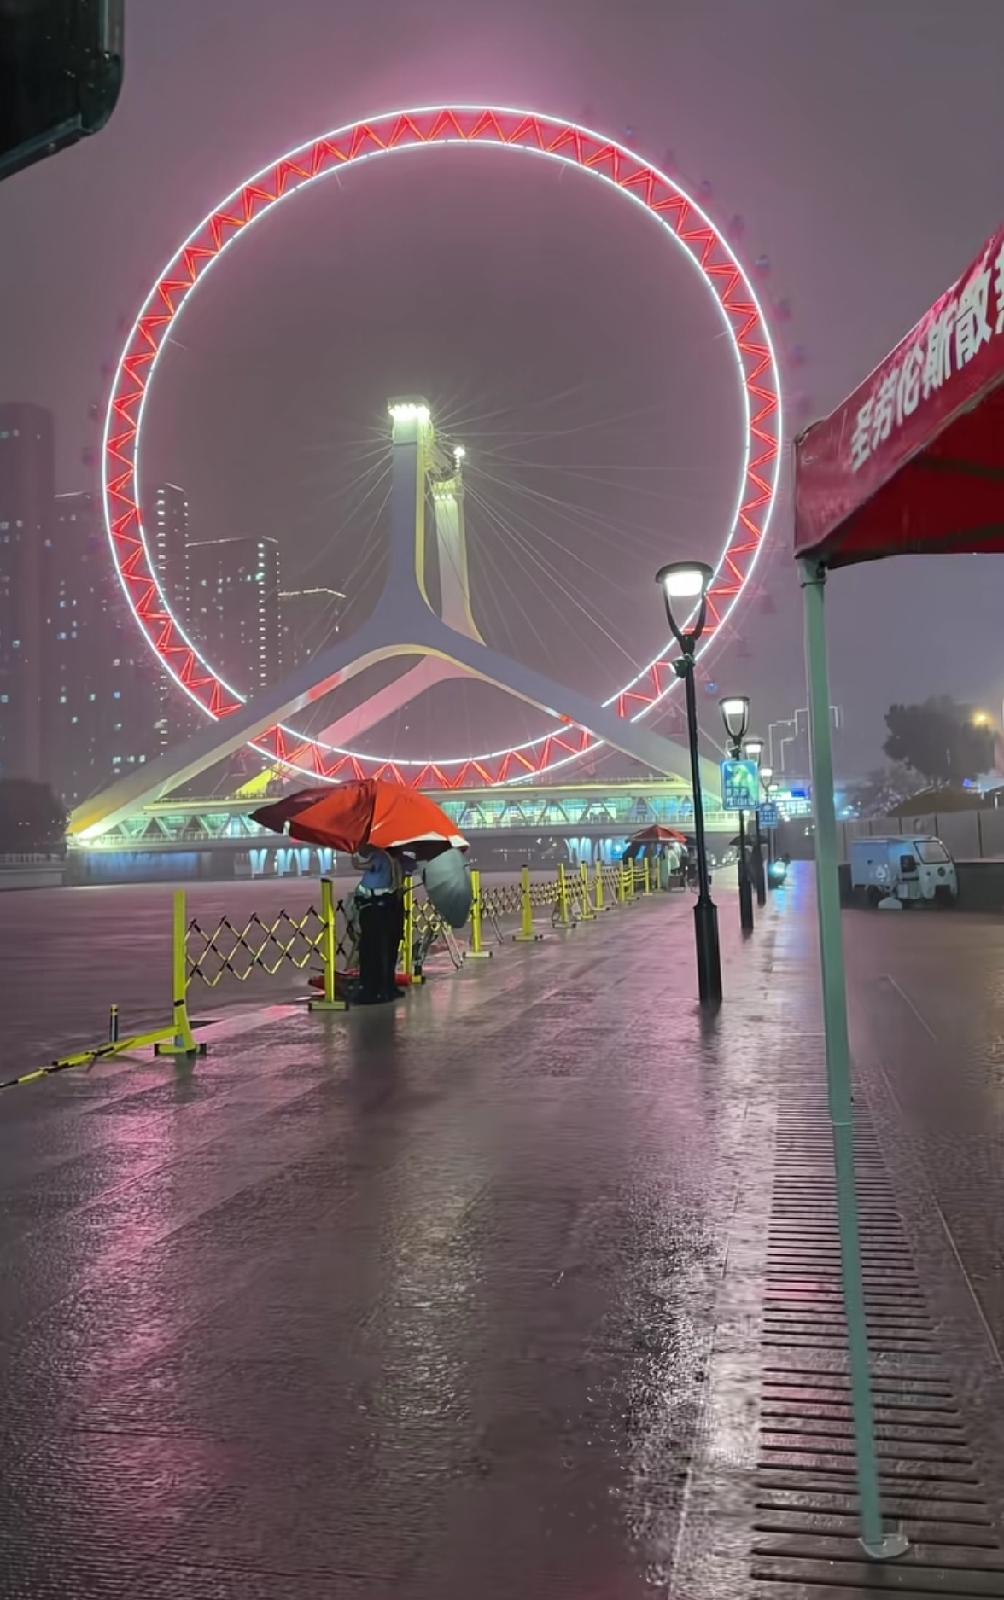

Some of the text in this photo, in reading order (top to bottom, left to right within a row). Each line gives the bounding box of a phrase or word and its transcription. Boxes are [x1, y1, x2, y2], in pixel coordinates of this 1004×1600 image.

[850, 242, 1004, 473] 圣劳伦斯散
